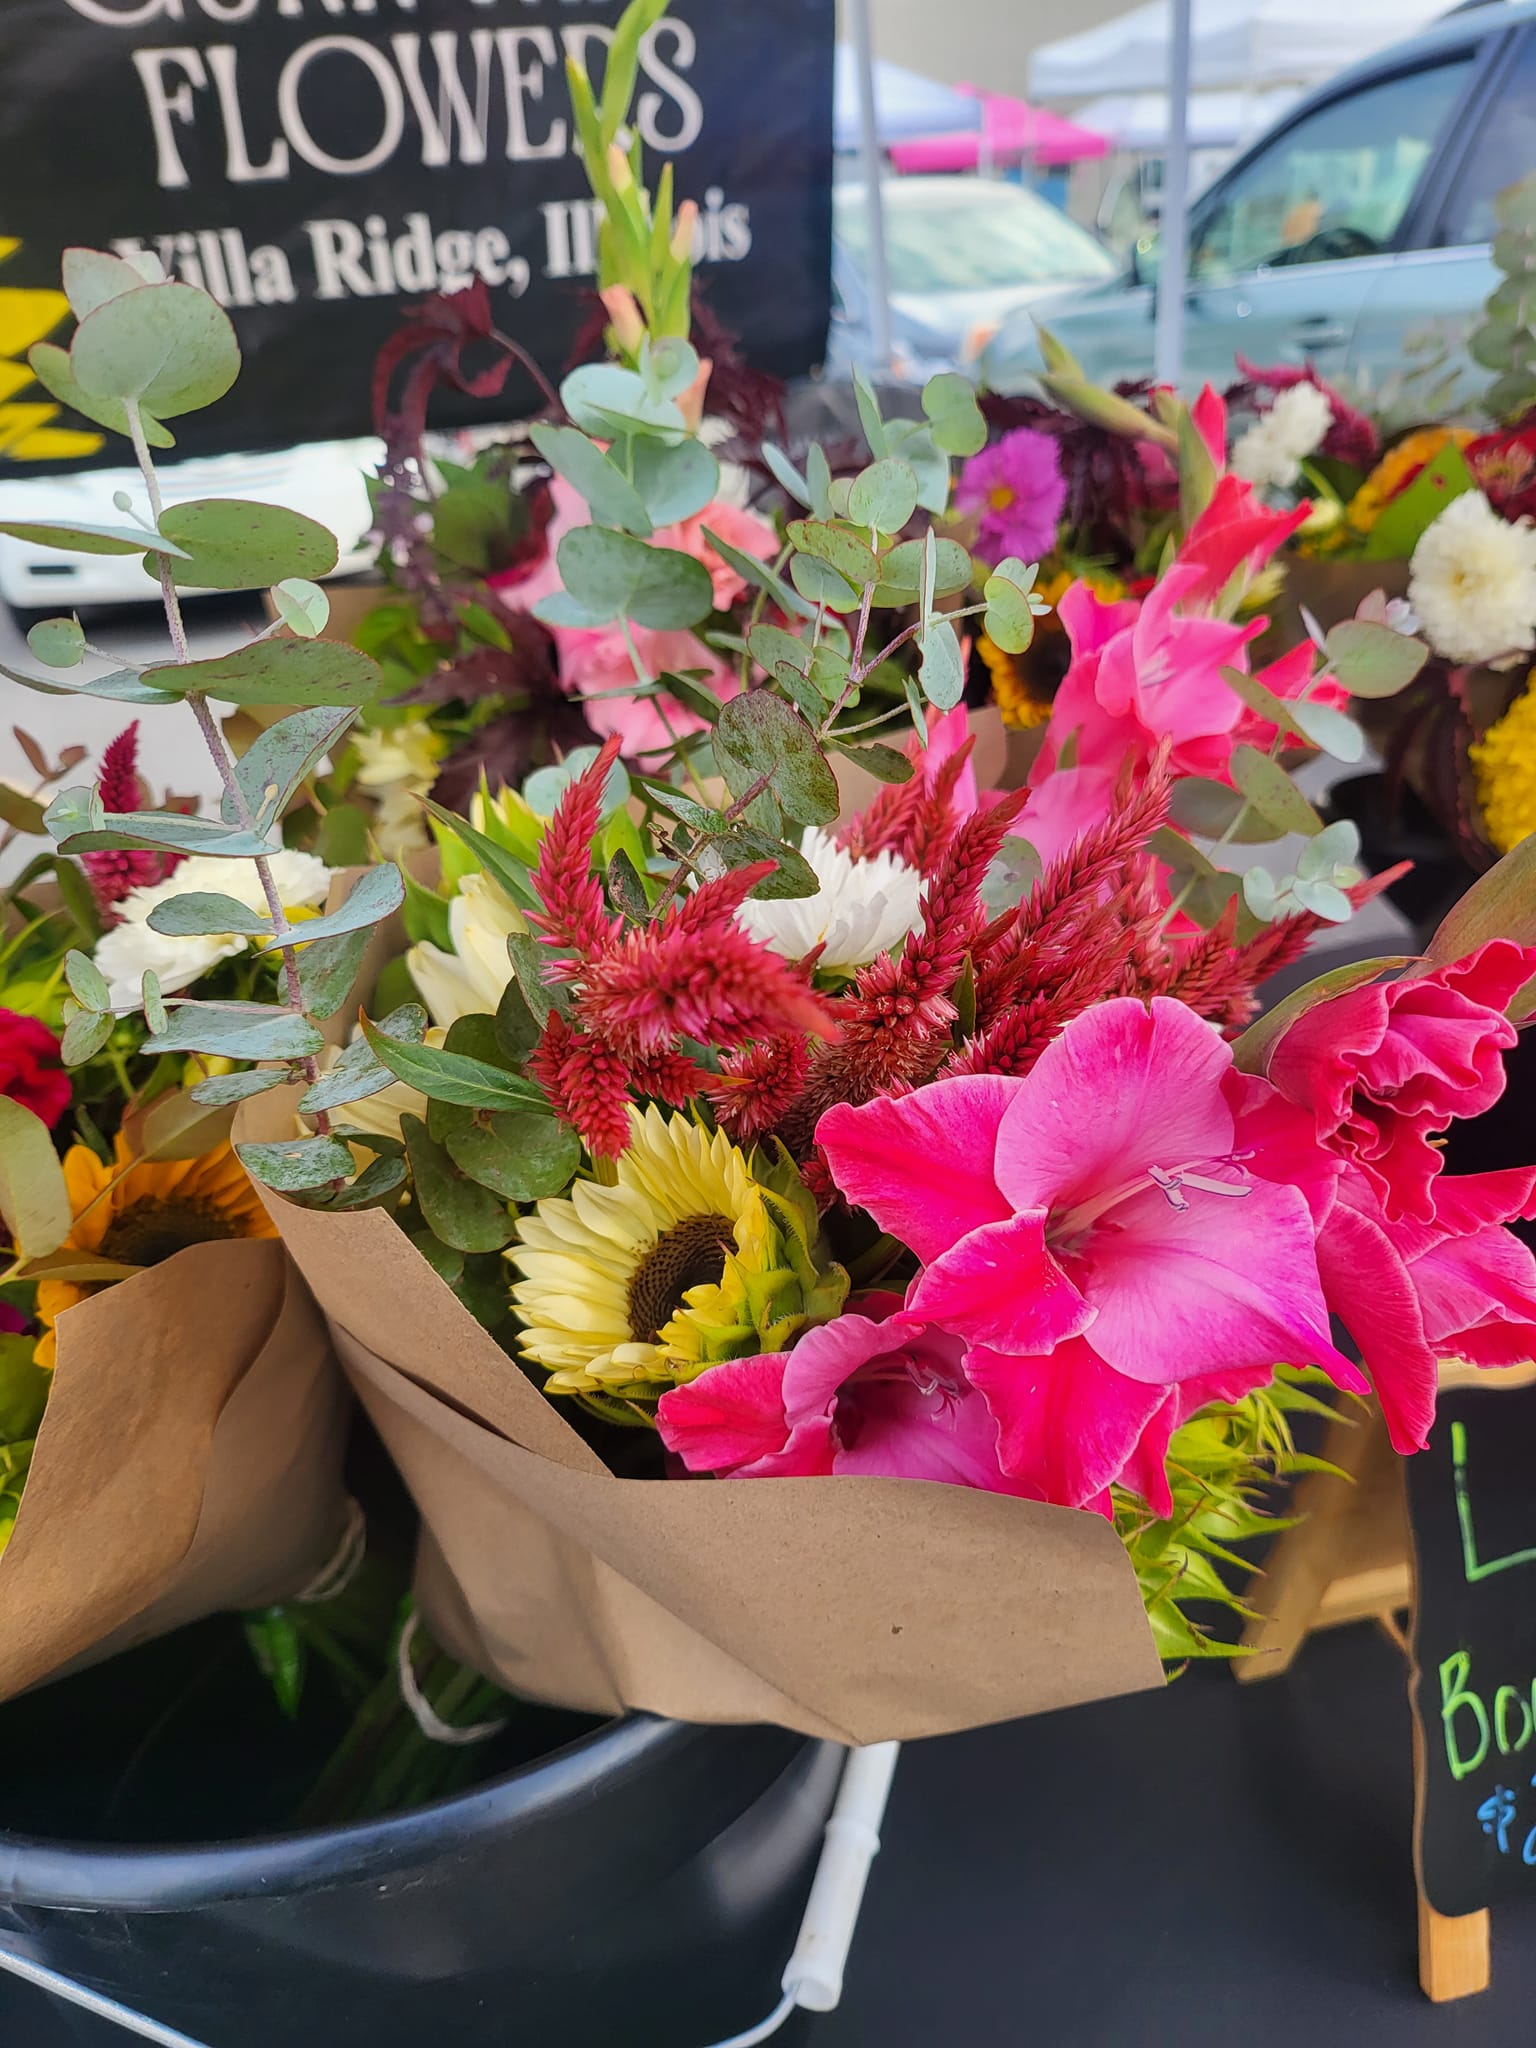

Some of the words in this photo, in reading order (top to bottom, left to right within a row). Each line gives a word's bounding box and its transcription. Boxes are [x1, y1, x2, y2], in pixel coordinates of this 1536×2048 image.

[303, 211, 531, 300] Ridge,
[540, 186, 752, 278] Ilois
[1439, 1650, 1536, 1781] Bo
